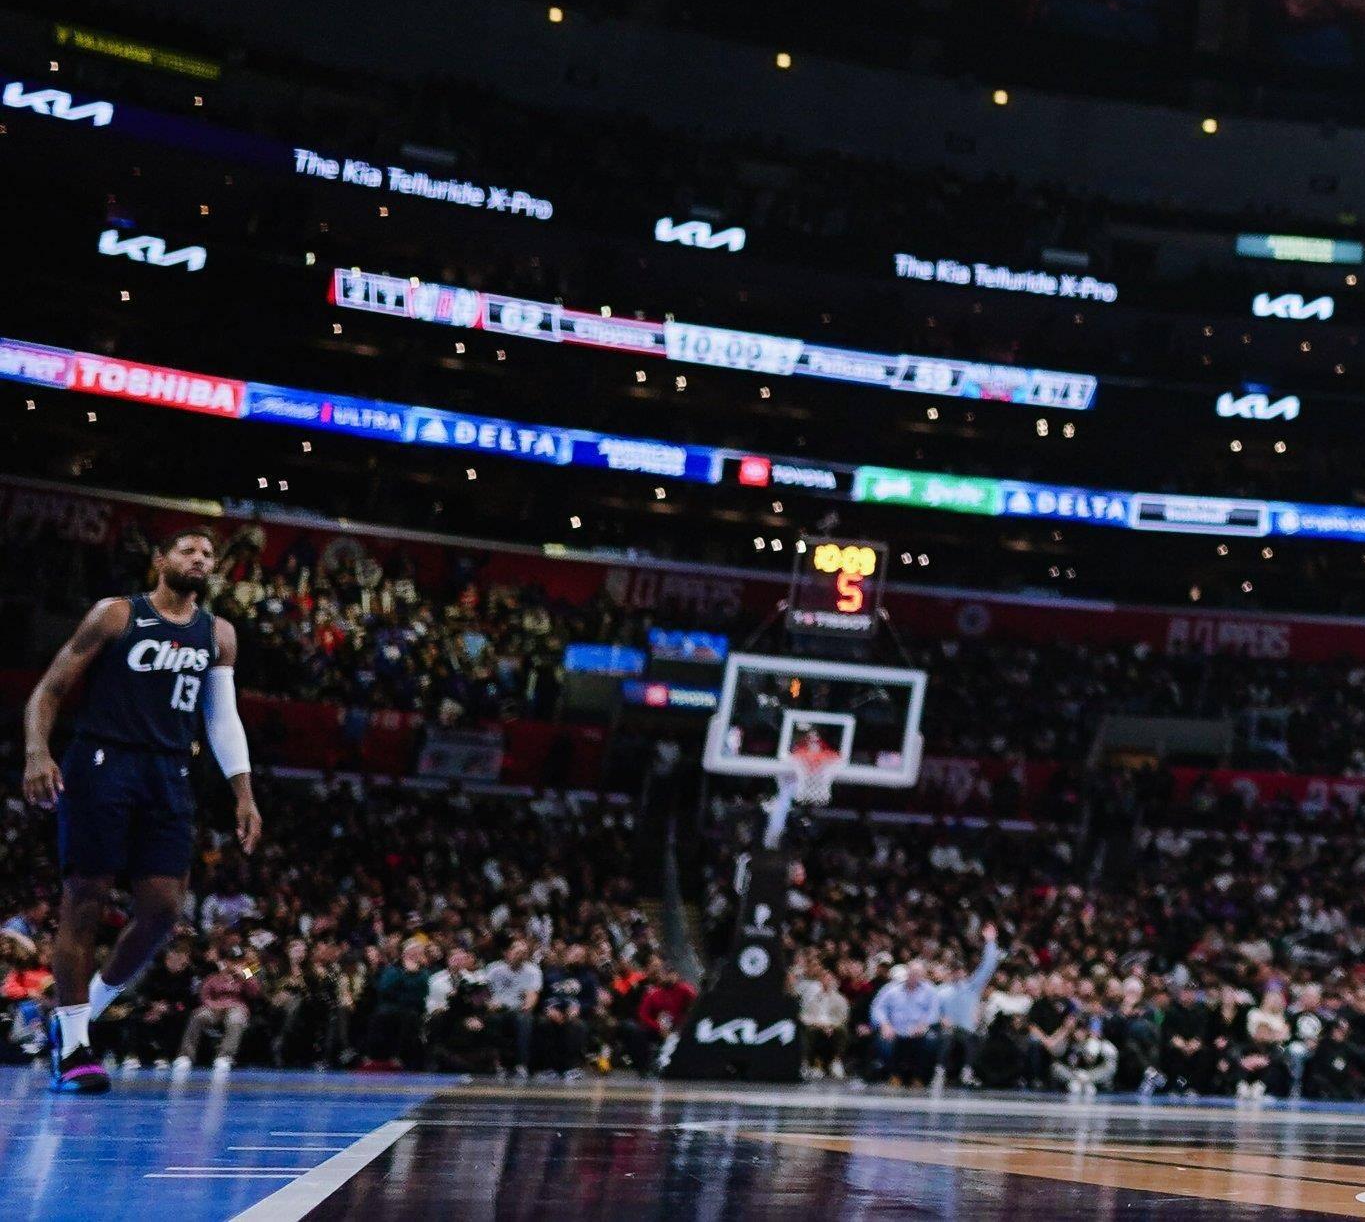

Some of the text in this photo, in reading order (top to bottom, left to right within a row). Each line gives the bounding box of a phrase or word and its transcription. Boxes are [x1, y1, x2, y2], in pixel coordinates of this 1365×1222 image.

[294, 148, 554, 220] The Kia Telluride X-Pro
[895, 253, 1118, 303] The Kia Telluride X-Pro
[77, 359, 235, 412] TOSHIBA
[453, 420, 556, 457] DELTA
[1037, 490, 1127, 521] DELTA
[836, 573, 864, 613] 5
[126, 638, 210, 674] Clips
[170, 673, 201, 713] 13
